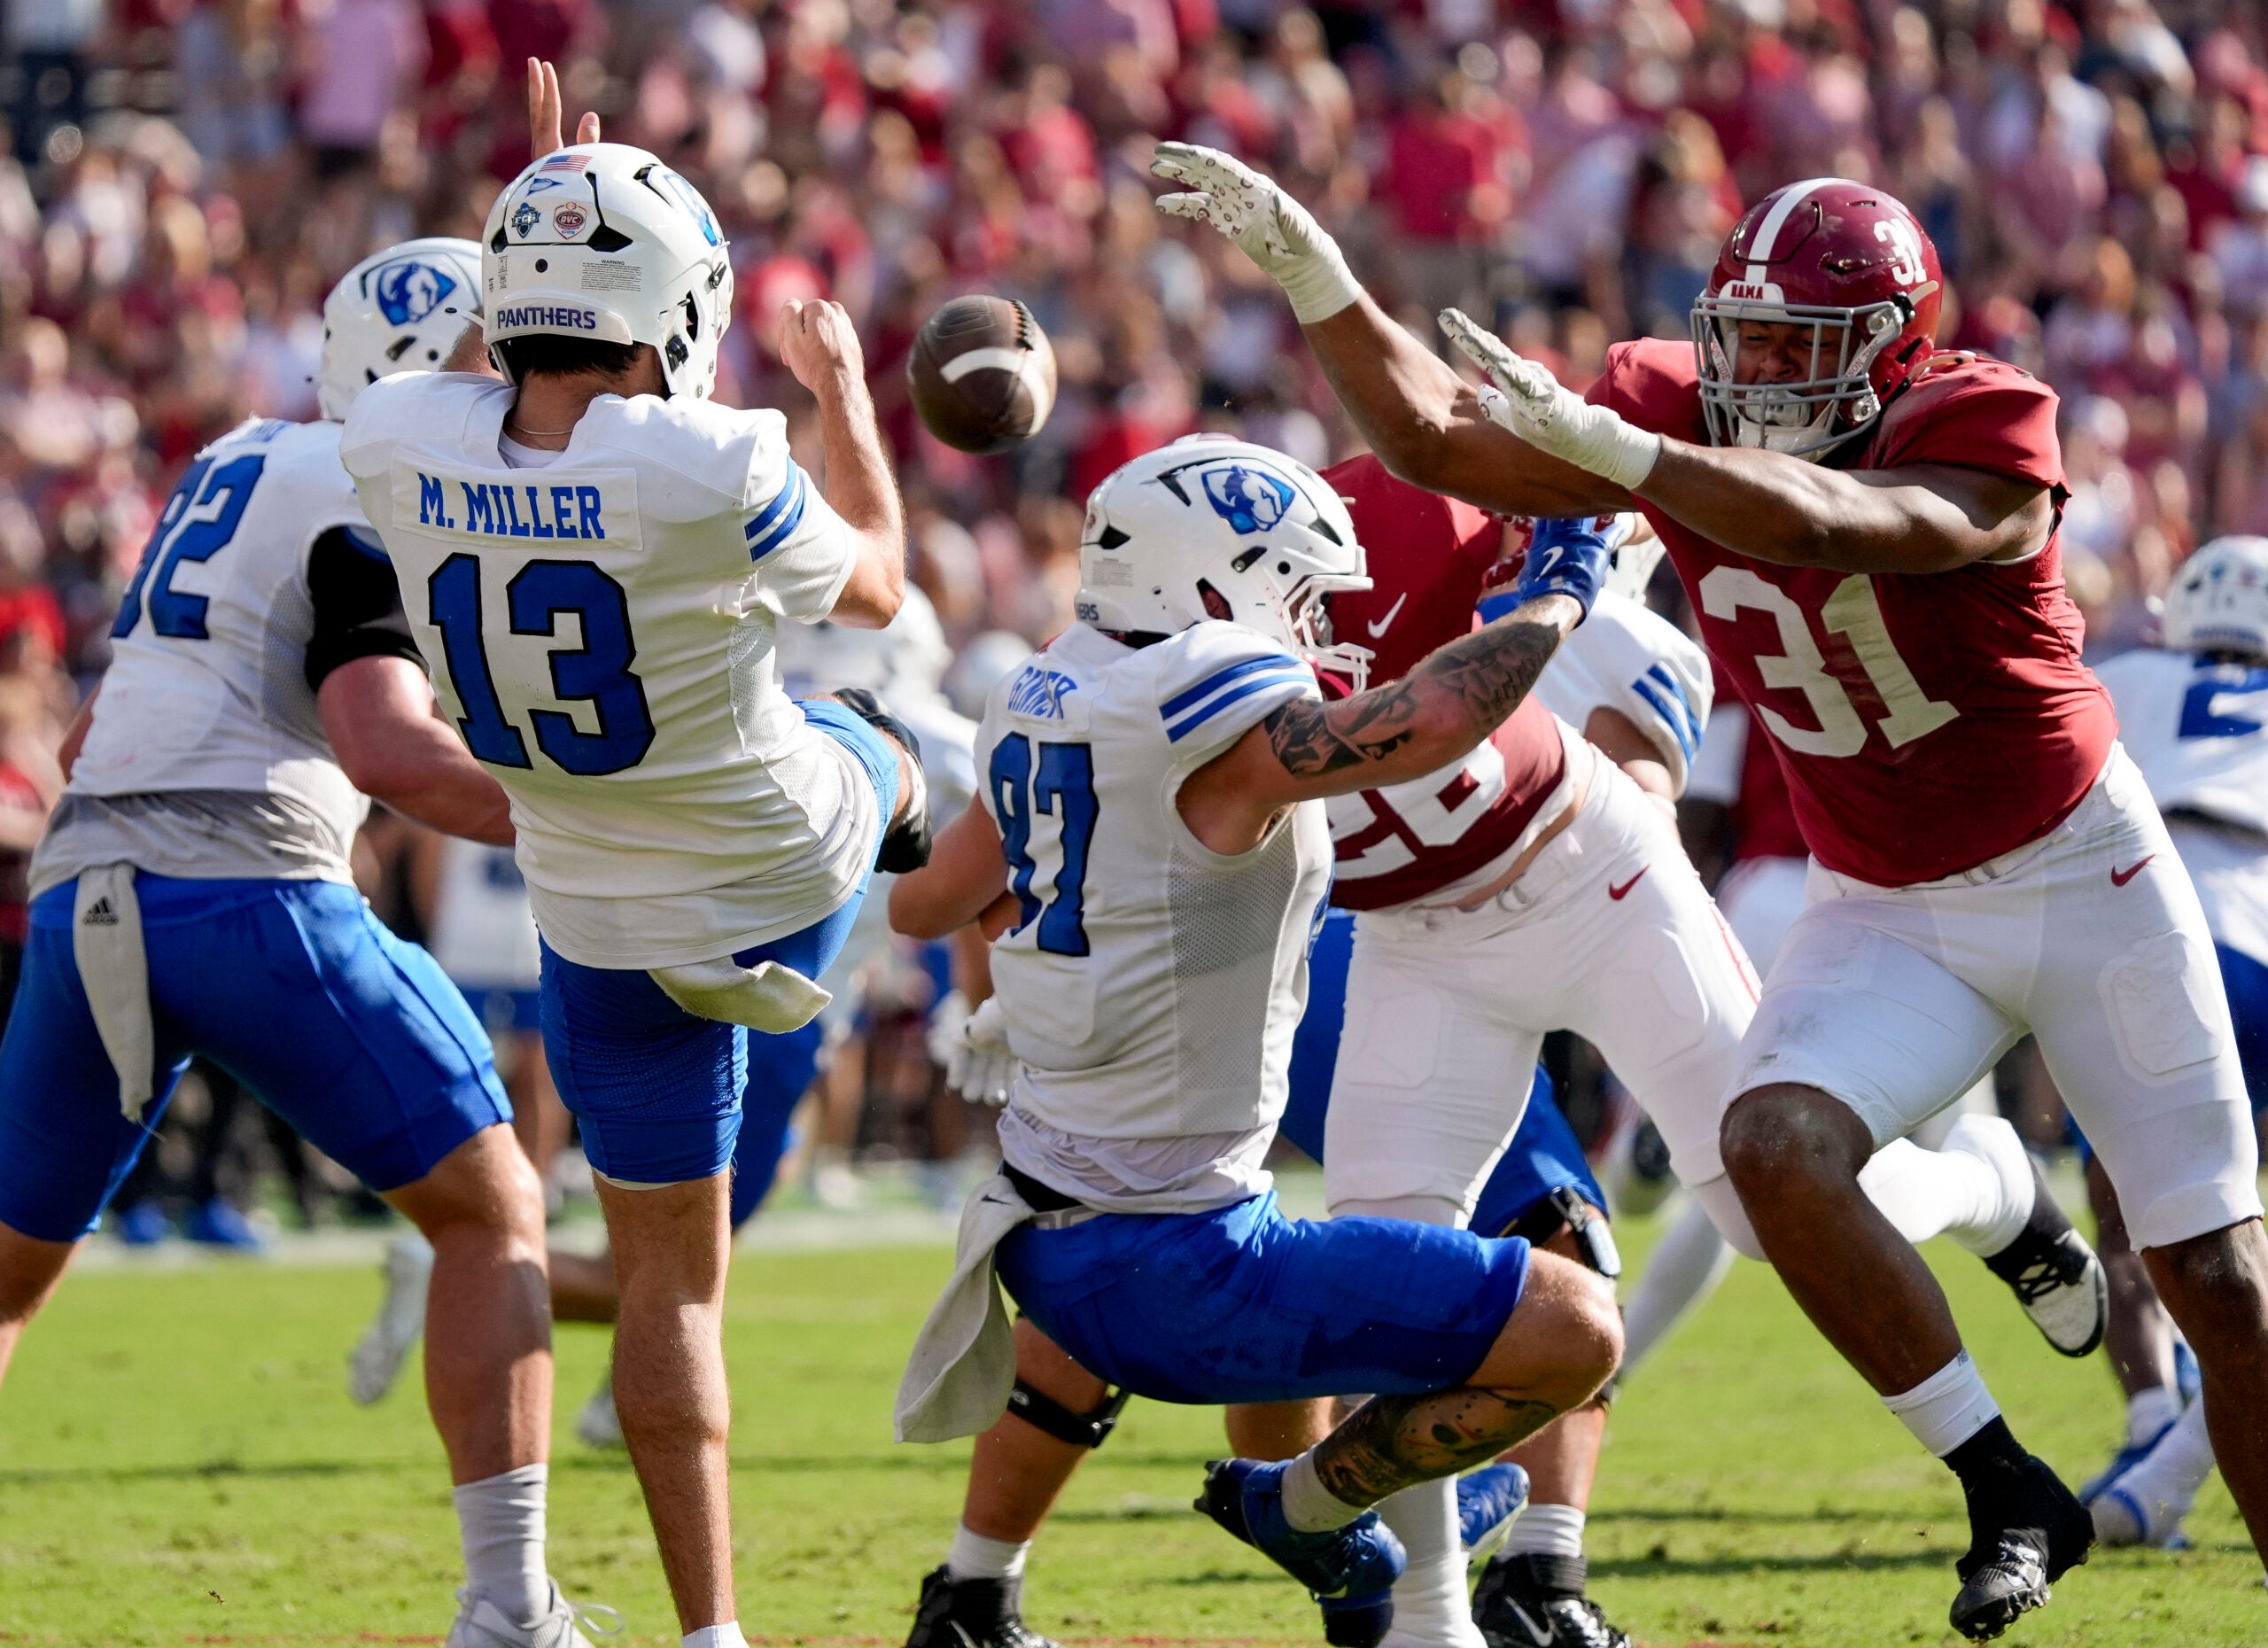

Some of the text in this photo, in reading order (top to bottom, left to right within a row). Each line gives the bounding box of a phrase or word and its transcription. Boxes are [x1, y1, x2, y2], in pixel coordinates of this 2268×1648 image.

[1873, 218, 1928, 285] 31
[497, 307, 596, 330] PANTHERS
[1730, 284, 1763, 299] BAMA
[417, 472, 605, 539] M. MILLER
[109, 454, 267, 640] 92
[428, 552, 656, 776] 13
[1698, 564, 1961, 758] 31
